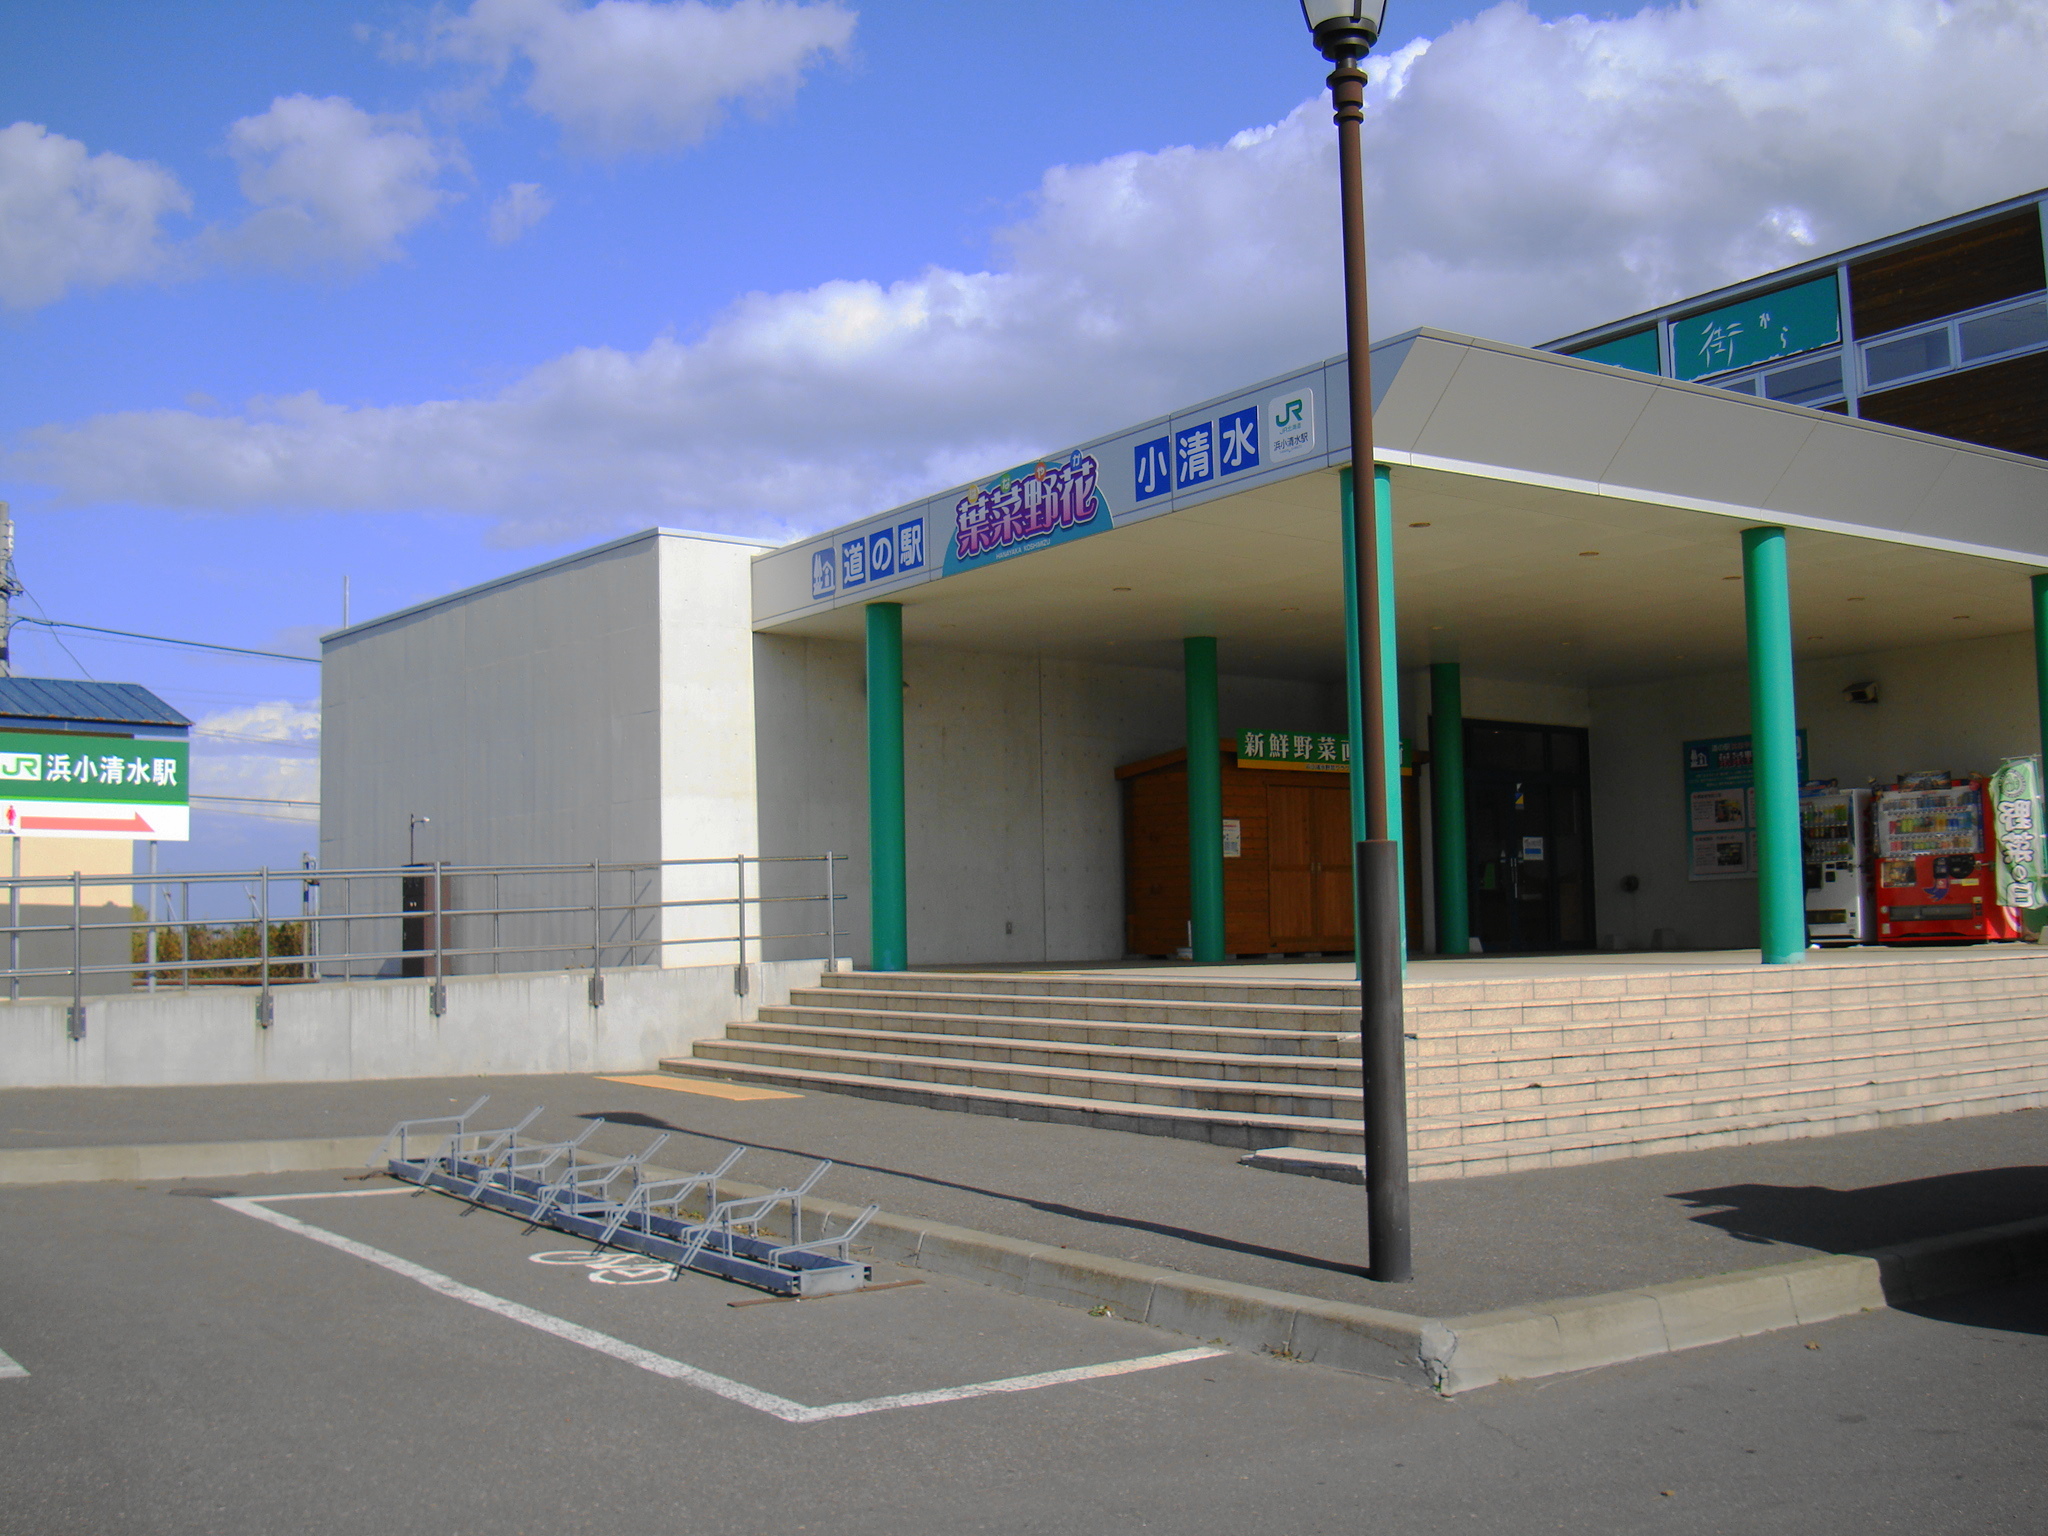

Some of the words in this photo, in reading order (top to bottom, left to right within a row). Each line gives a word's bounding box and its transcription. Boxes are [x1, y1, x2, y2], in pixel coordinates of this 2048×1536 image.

[1275, 399, 1303, 428] JR
[1137, 417, 1256, 493] 小清水
[1273, 431, 1309, 452] 浜小清水駅
[957, 459, 1096, 557] 葉菜野花
[844, 524, 922, 584] 道の駅
[2, 757, 38, 777] JR
[46, 754, 177, 786] 浜小清水駅
